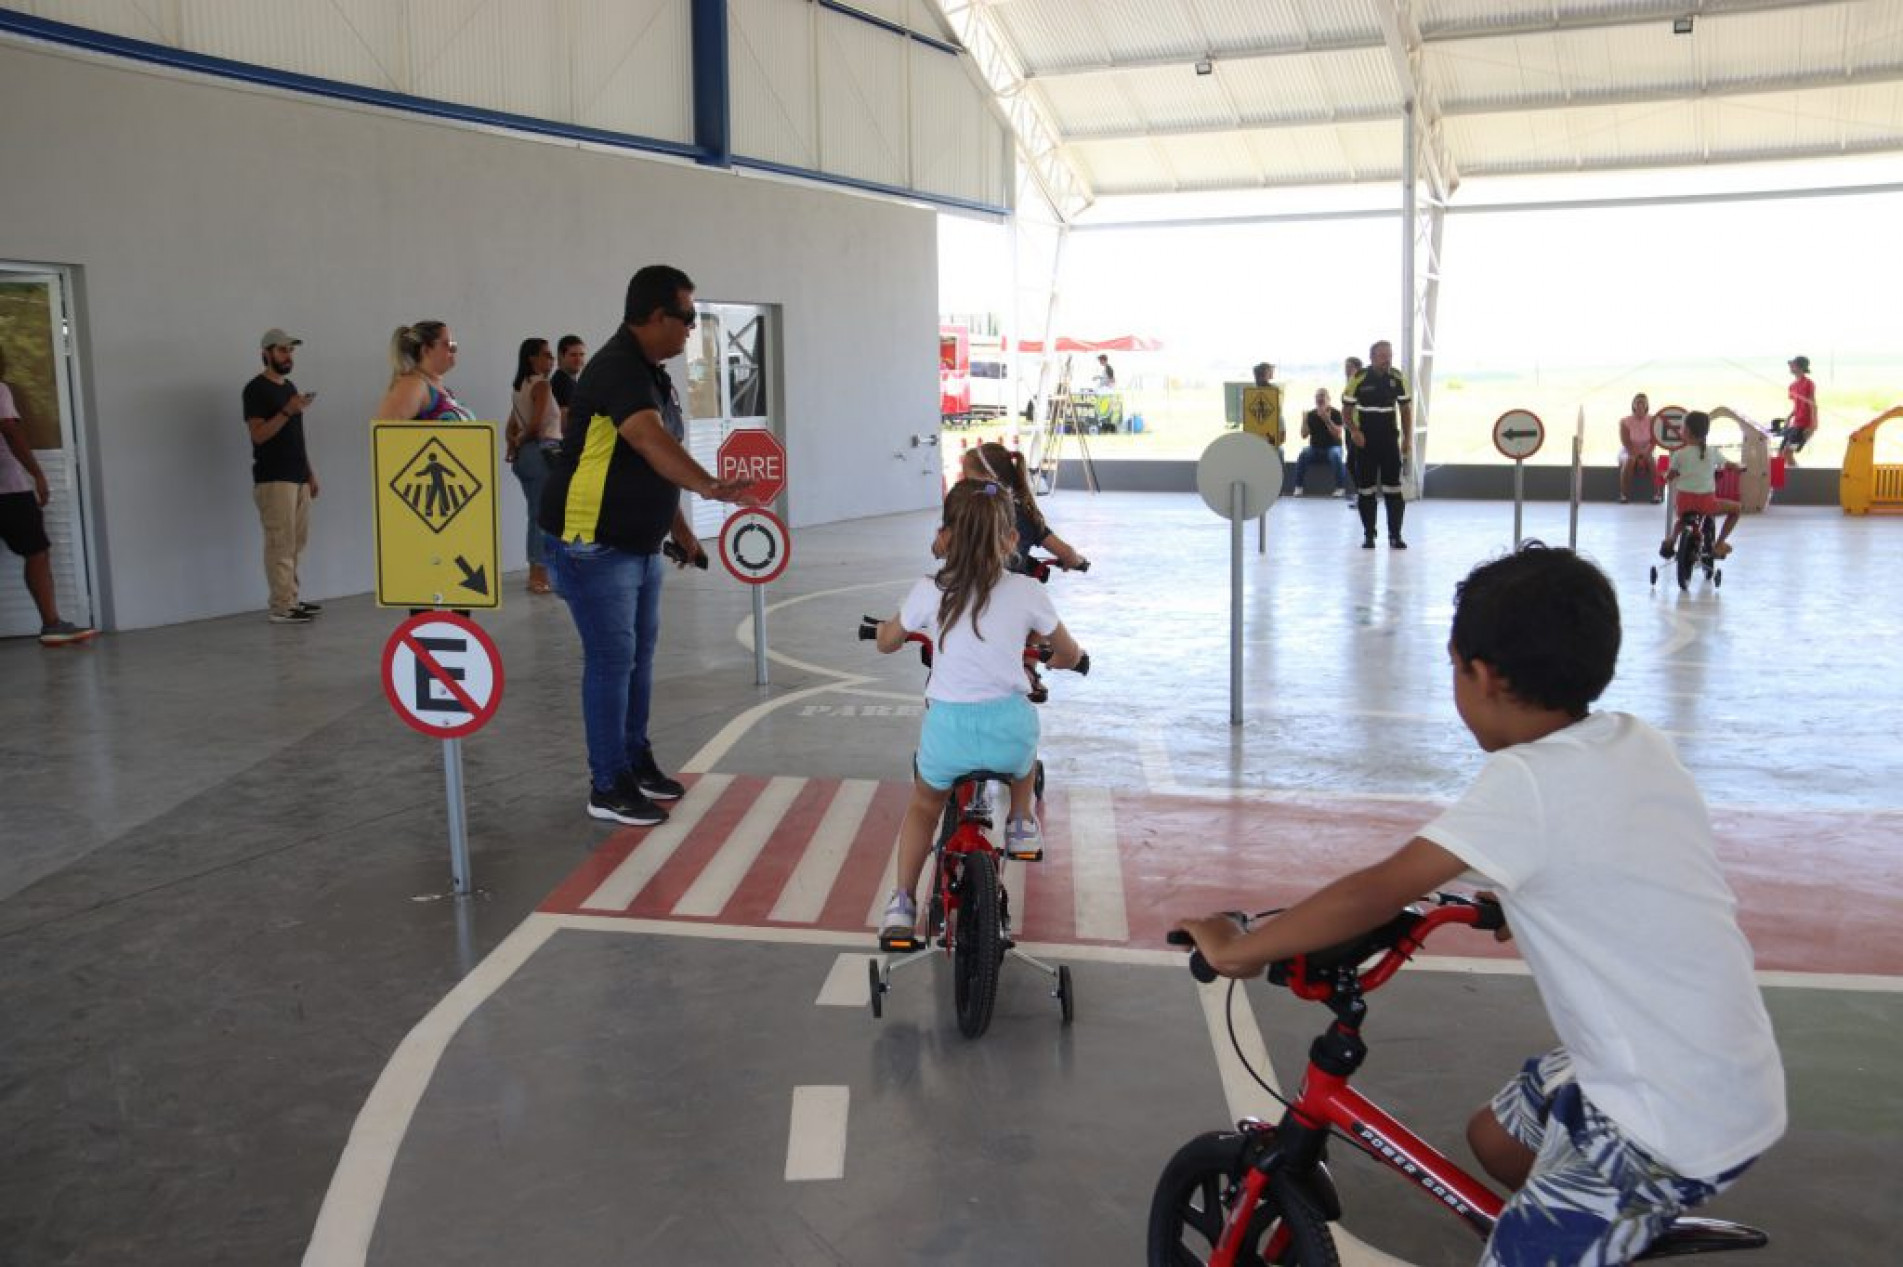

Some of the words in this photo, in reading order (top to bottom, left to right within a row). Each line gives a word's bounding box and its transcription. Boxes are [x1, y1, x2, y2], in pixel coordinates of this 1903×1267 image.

[723, 456, 780, 480] PARE
[414, 636, 470, 712] E
[1360, 1129, 1417, 1174] POWER
[1422, 1177, 1469, 1214] GAME
